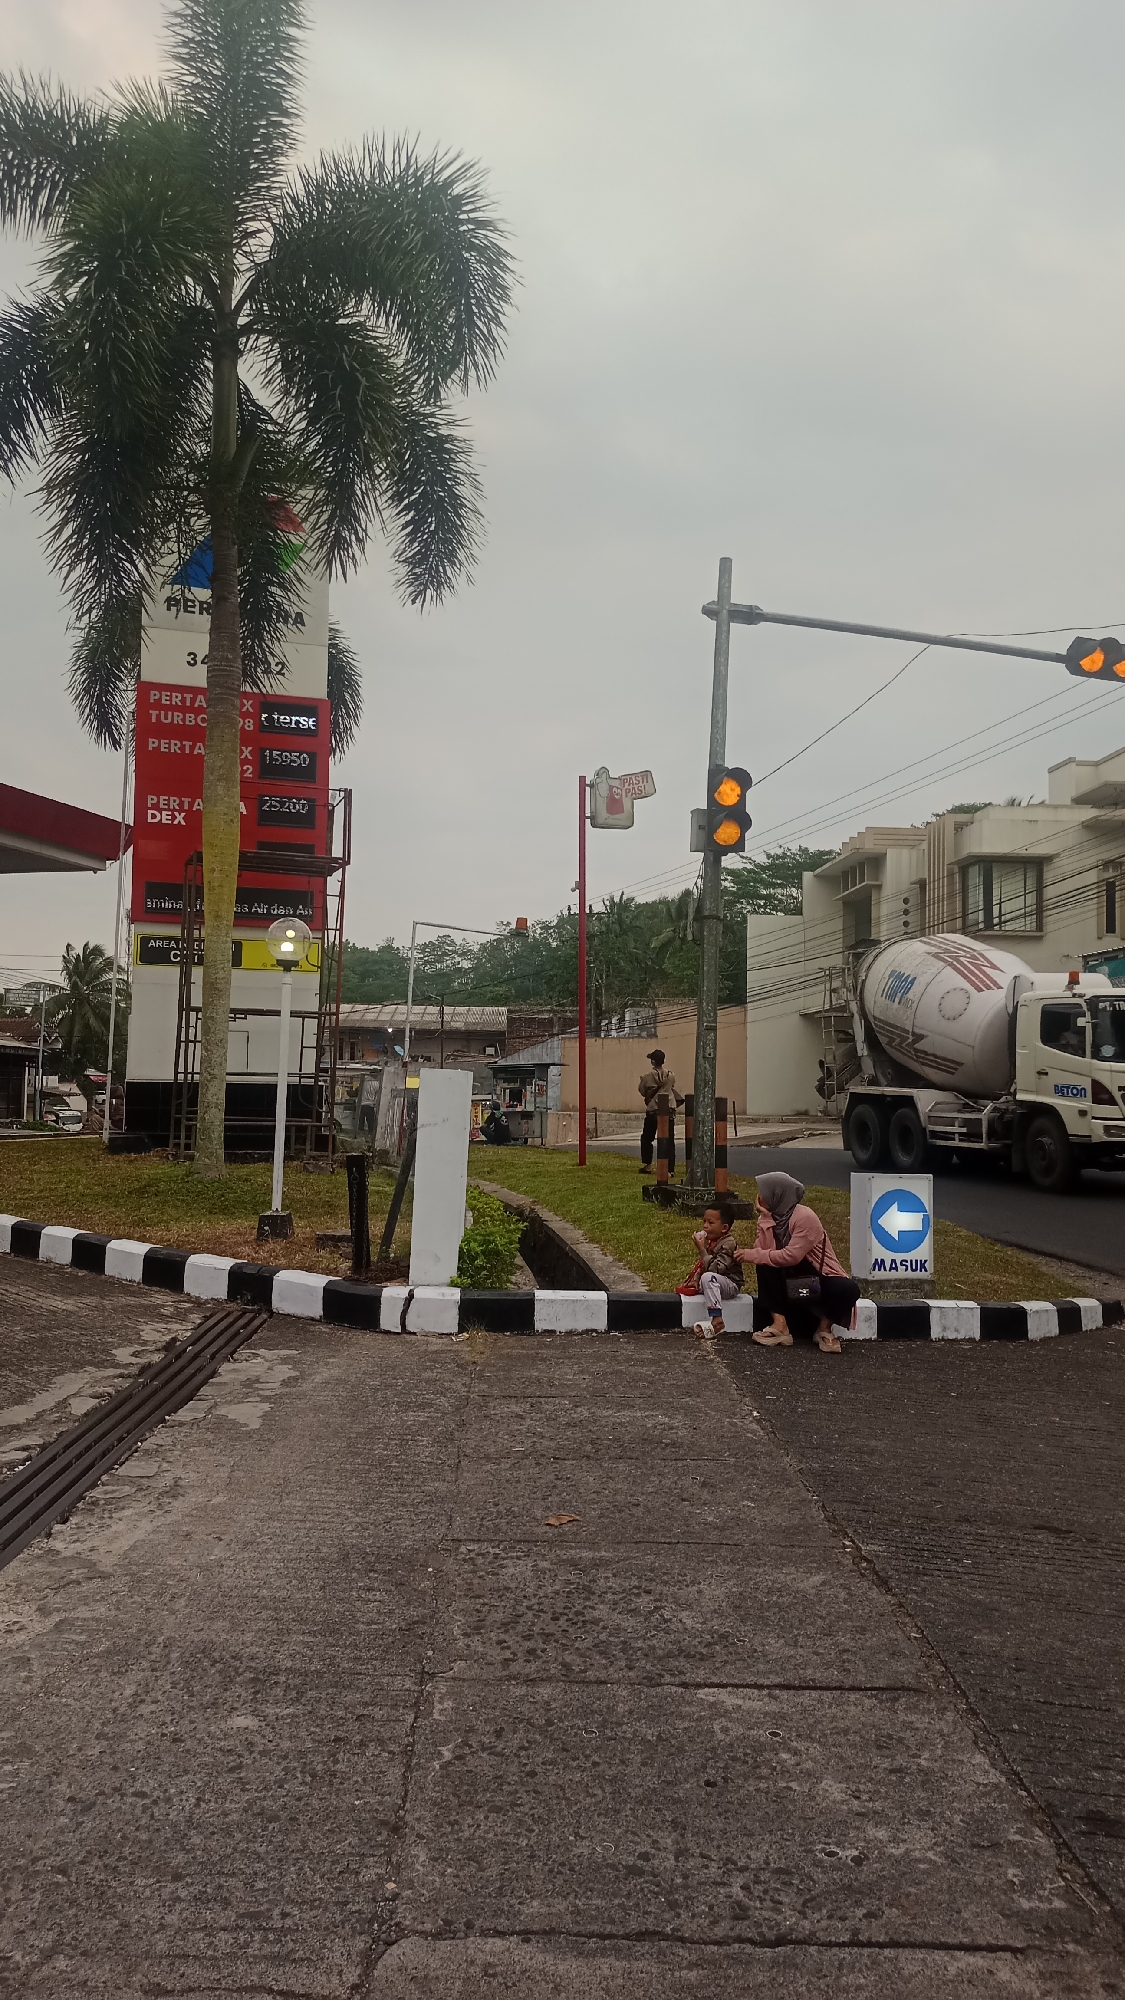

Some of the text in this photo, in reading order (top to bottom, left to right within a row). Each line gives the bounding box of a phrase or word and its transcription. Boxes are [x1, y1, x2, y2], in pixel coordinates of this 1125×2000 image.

[150, 690, 254, 713] PERTAX
[148, 738, 253, 760] PERTAX
[263, 749, 310, 767] 15950
[622, 774, 649, 788] PASTI
[624, 784, 647, 798] PAS!
[147, 809, 187, 826] DEX
[148, 939, 177, 949] AREA
[871, 1258, 929, 1273] MASUK
